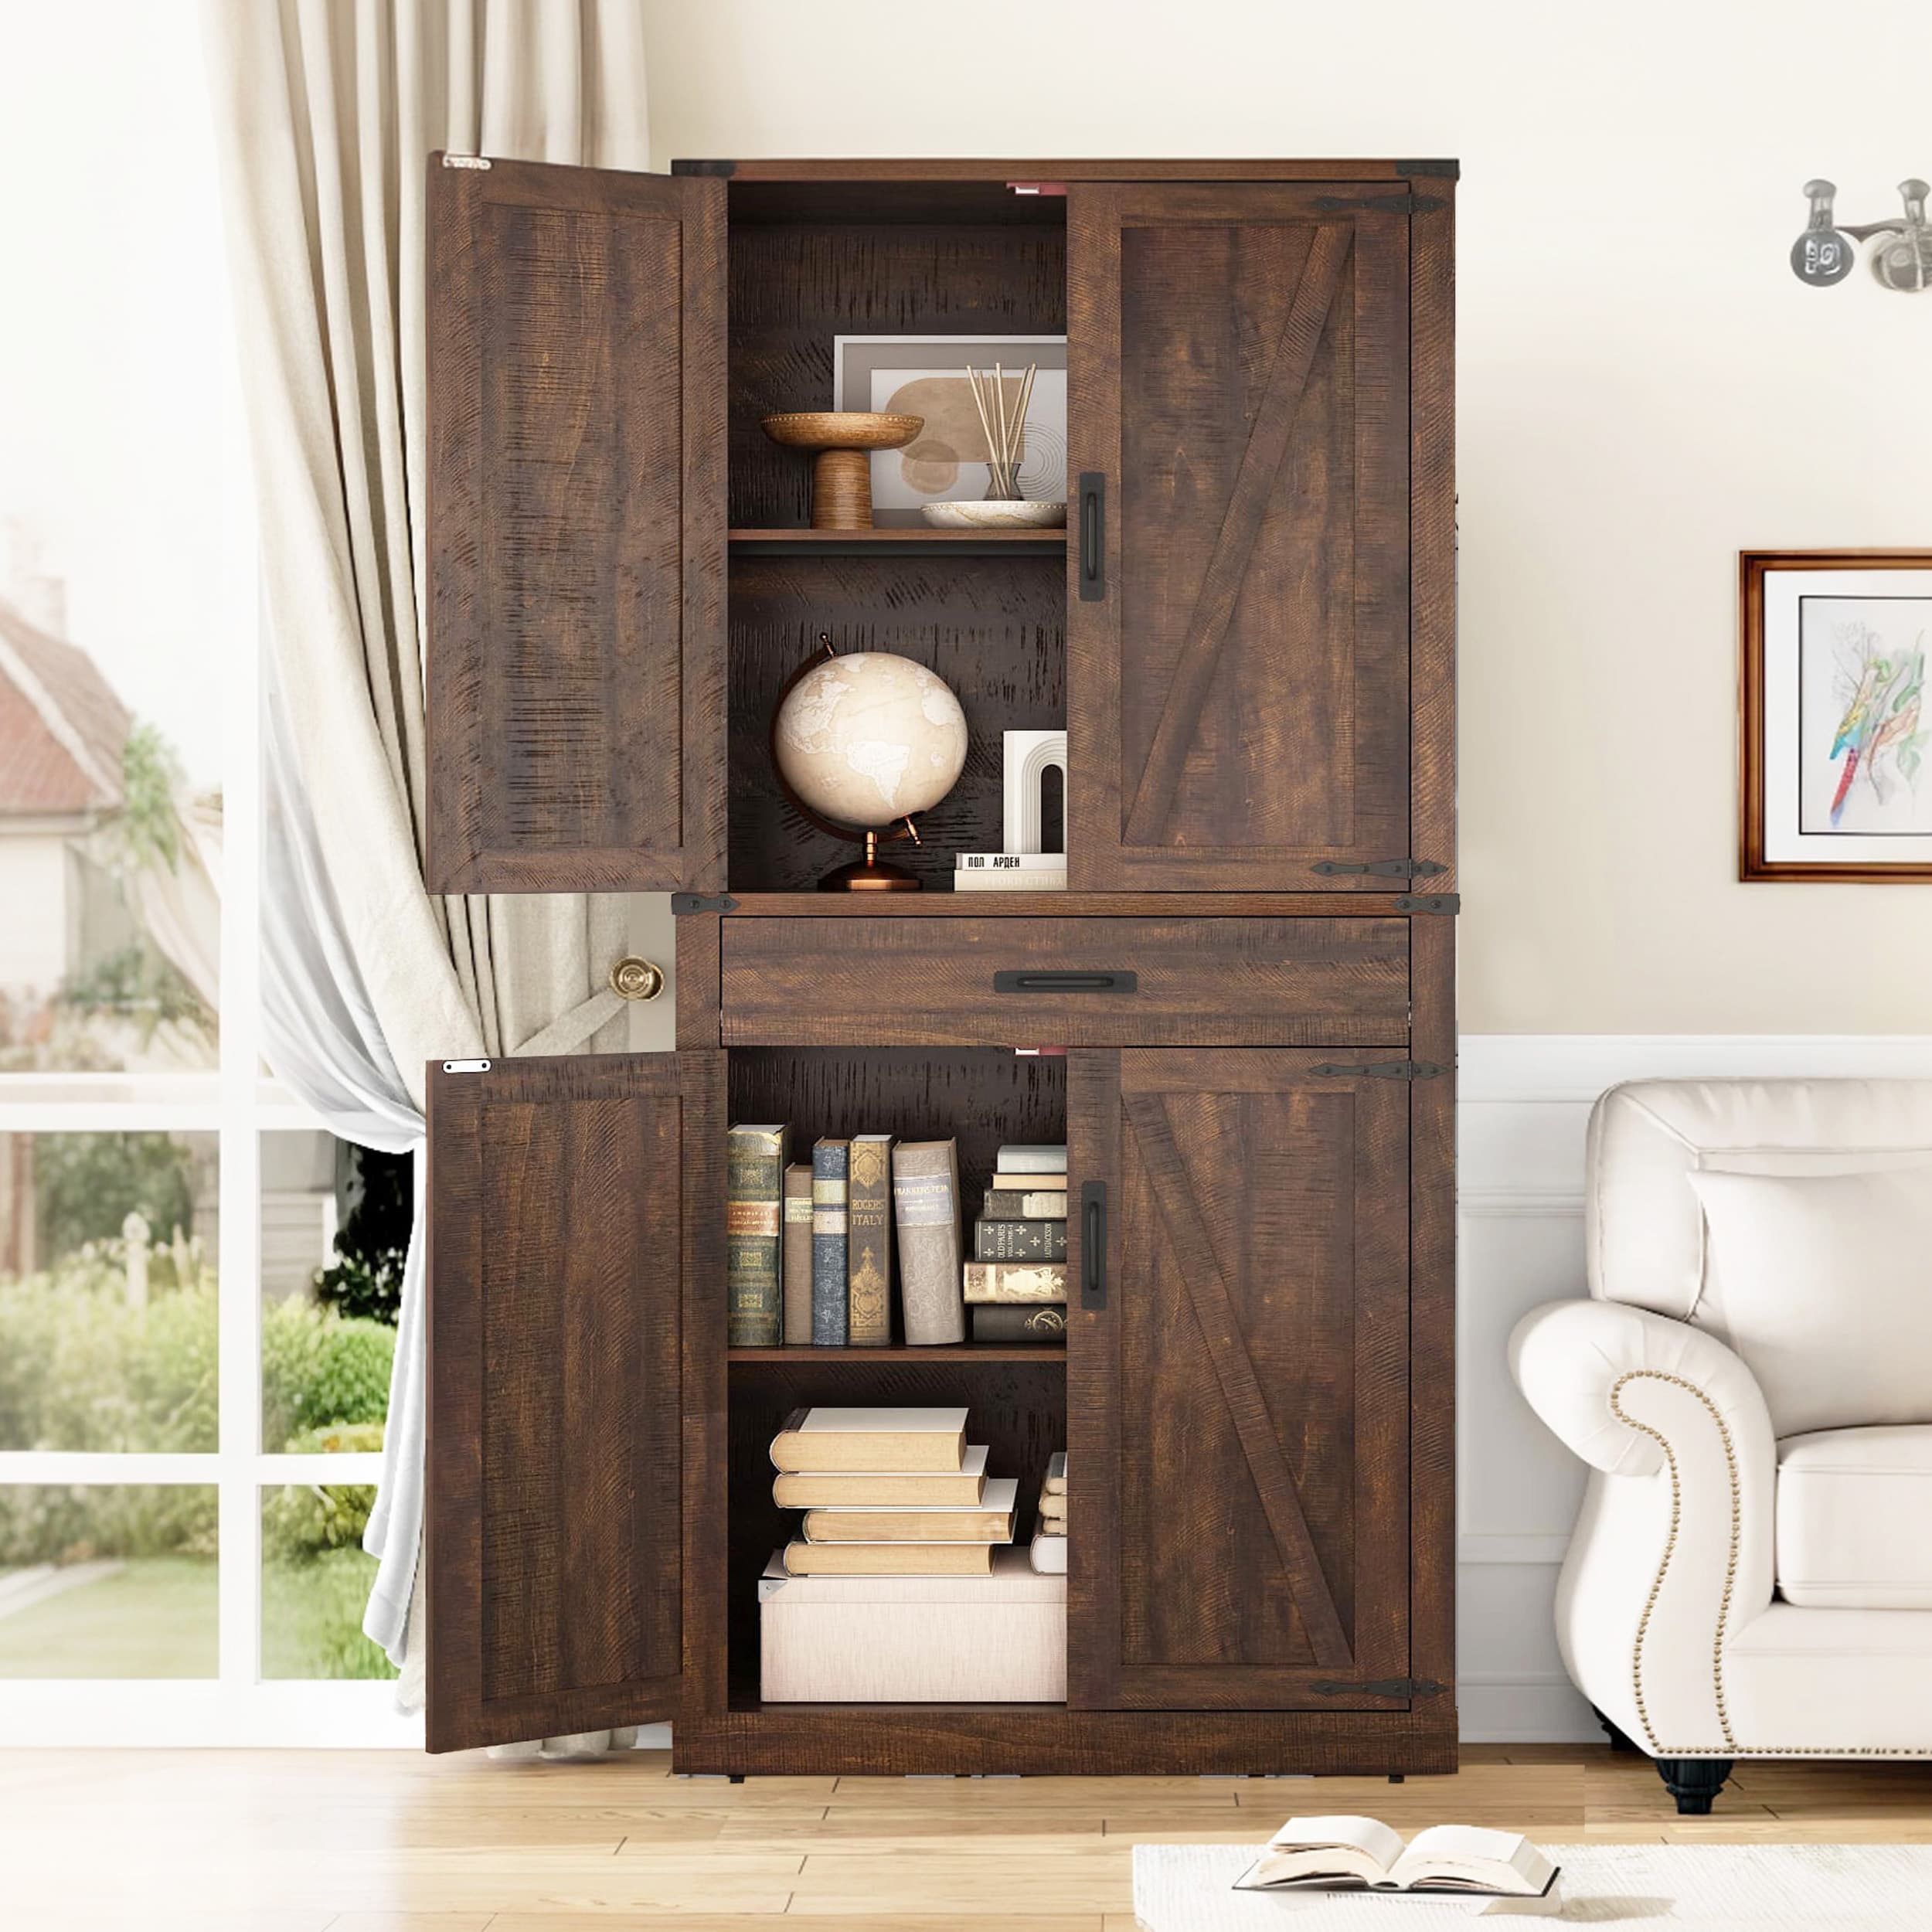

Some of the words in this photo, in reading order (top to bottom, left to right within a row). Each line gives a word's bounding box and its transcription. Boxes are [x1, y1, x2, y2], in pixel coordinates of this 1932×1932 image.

[968, 856, 985, 868] ПОЛ
[993, 856, 1020, 869] АРДЕН
[852, 1214, 884, 1226] ITALY
